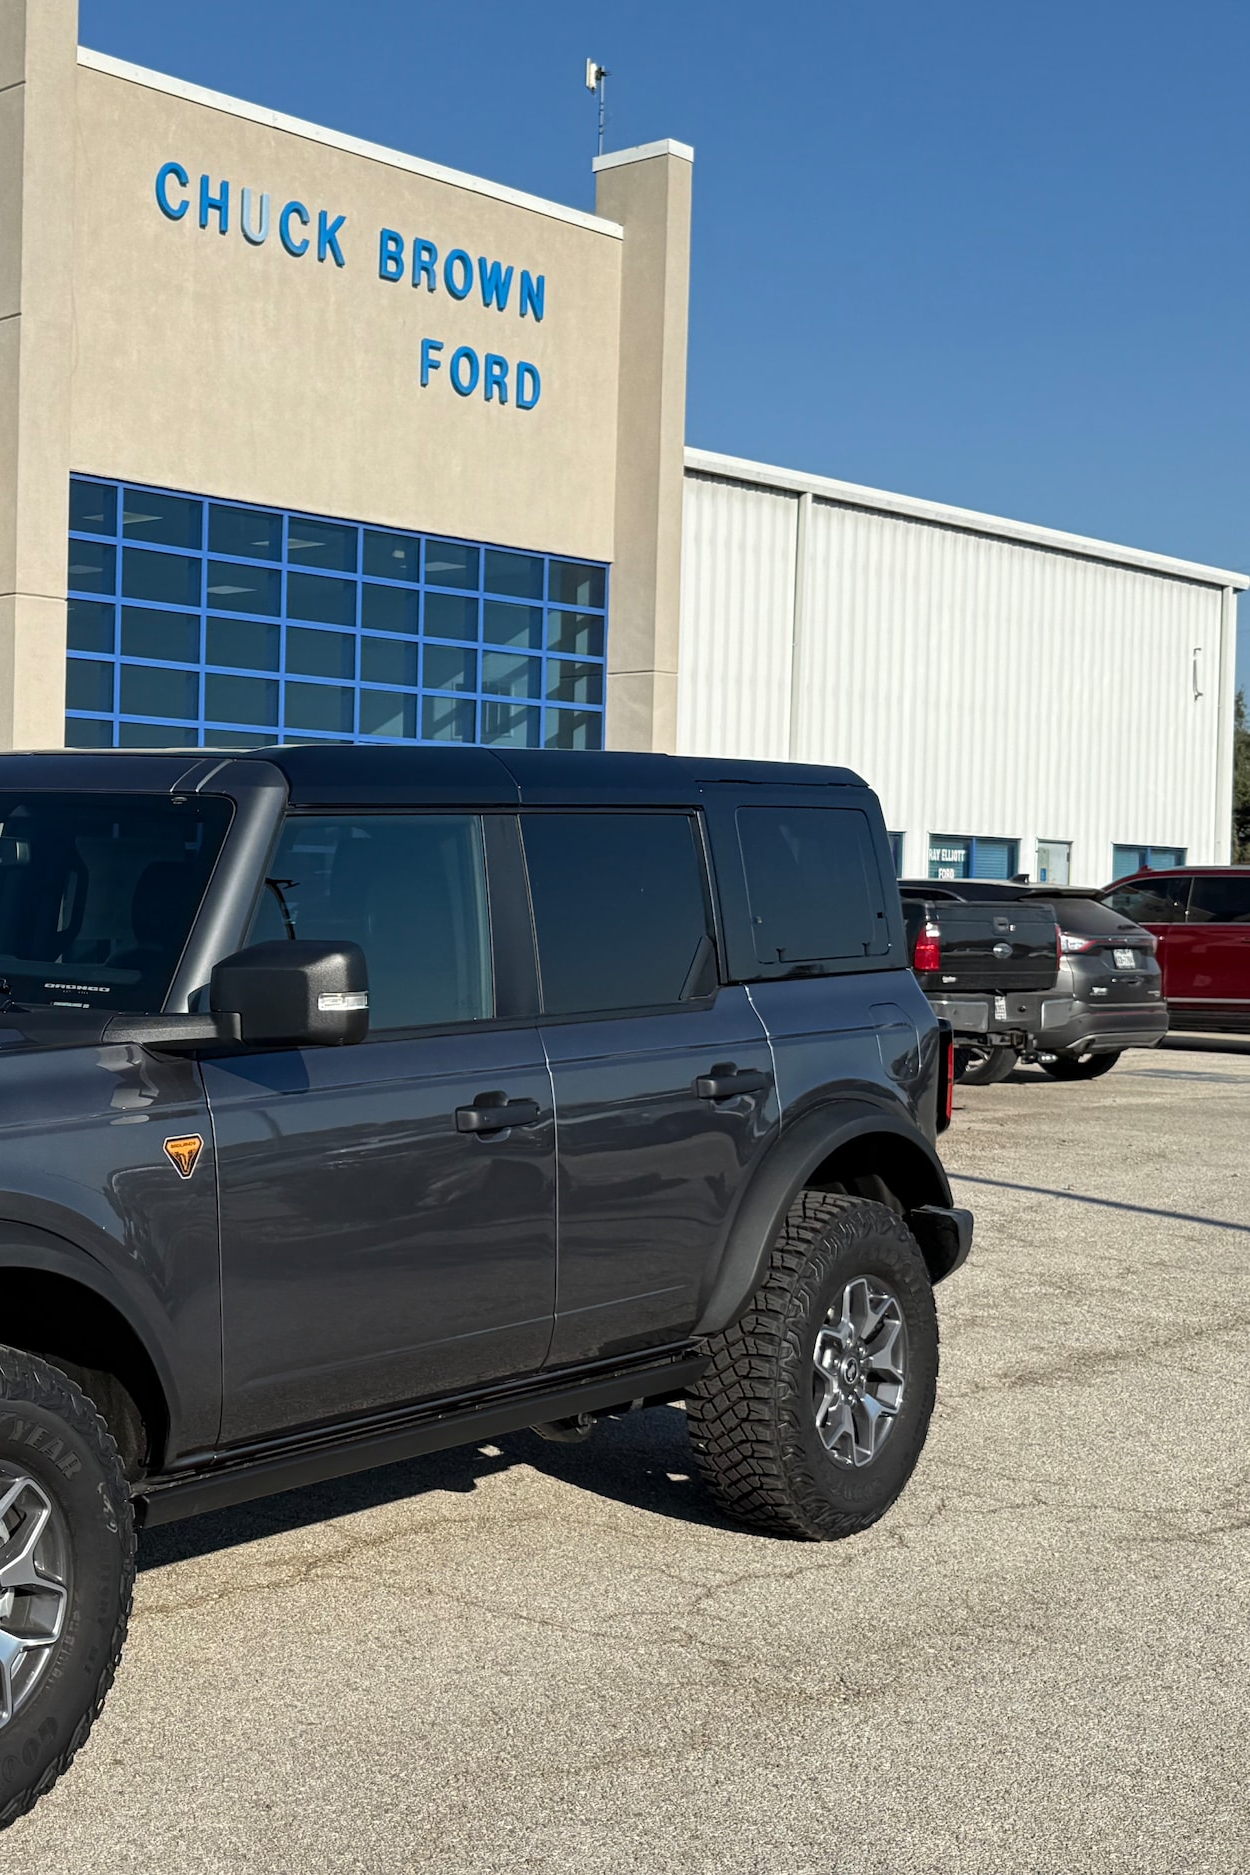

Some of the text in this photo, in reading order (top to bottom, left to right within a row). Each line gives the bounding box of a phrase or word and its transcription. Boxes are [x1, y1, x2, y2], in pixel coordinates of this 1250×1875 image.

[155, 162, 545, 322] CHUCK BROWN
[420, 338, 541, 410] FORD
[928, 848, 965, 862] RAY ELLIOTT
[938, 867, 955, 879] FORD
